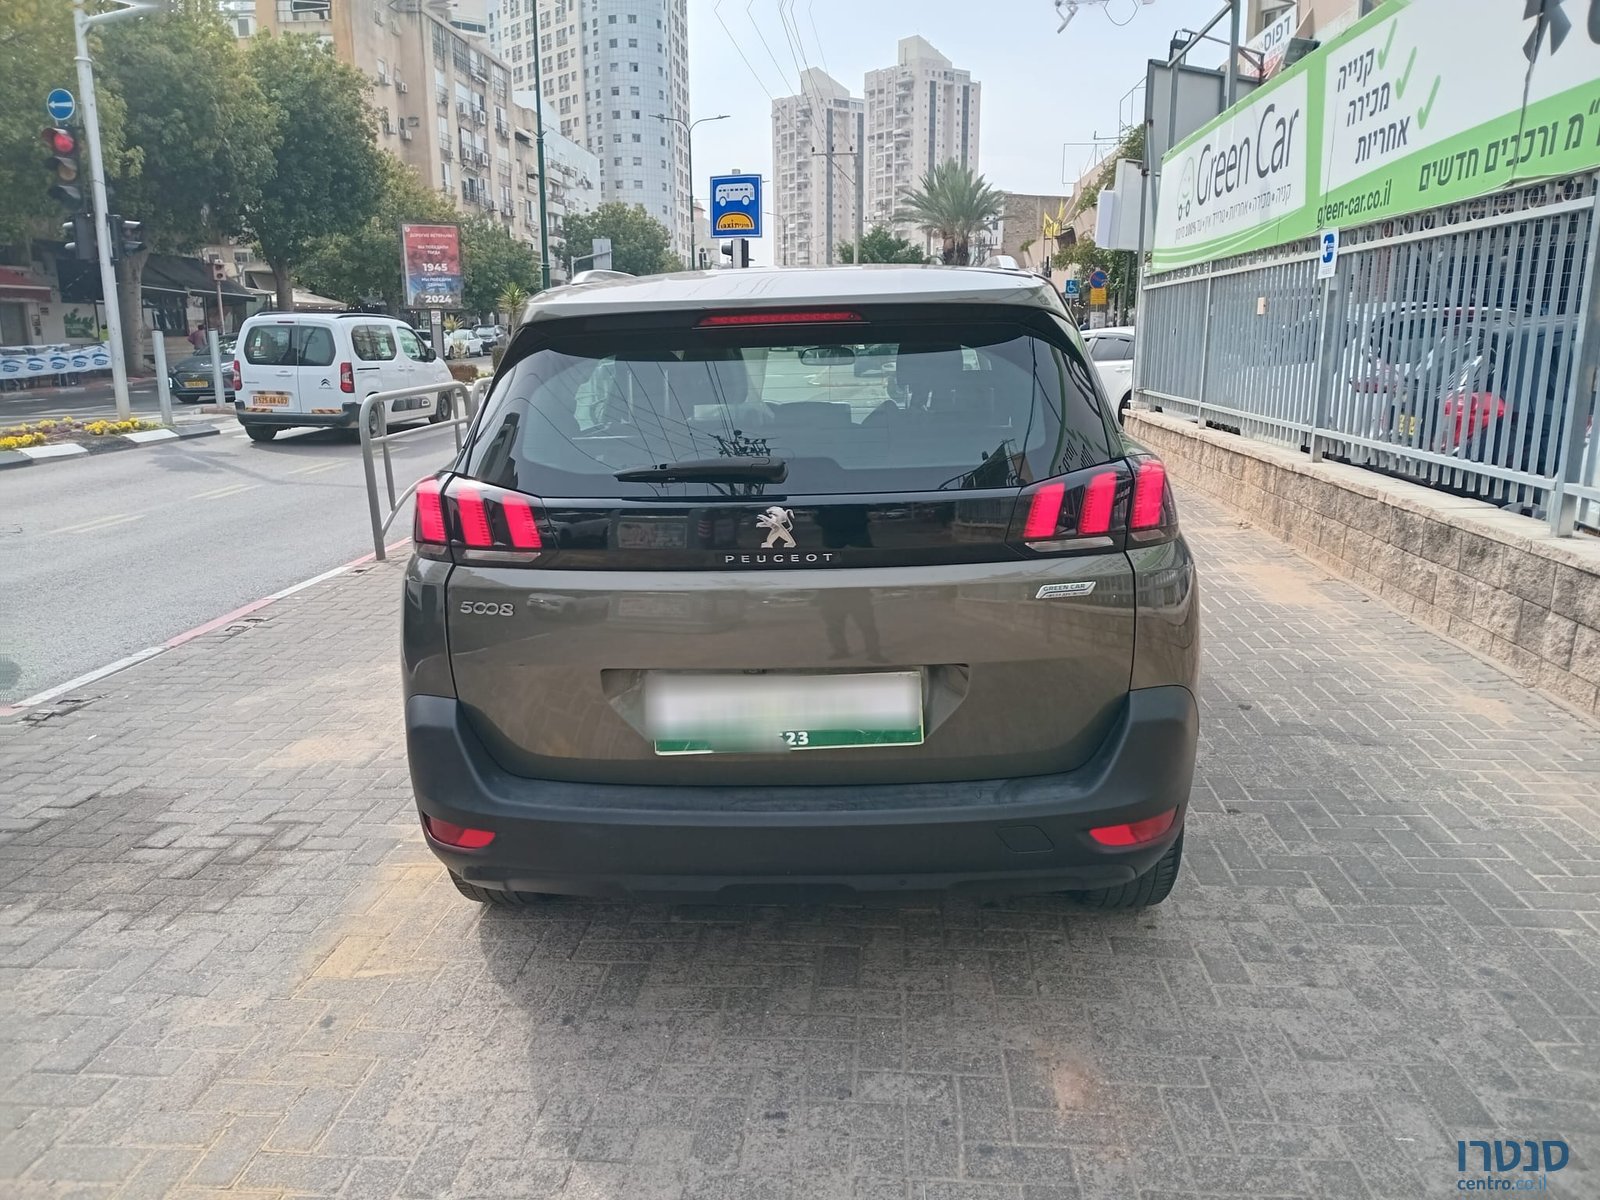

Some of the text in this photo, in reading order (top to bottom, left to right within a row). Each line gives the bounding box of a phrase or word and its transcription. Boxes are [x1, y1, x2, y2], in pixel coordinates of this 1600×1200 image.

[1264, 16, 1291, 51] דפוס
[1337, 48, 1375, 93] קנייה
[1346, 82, 1390, 127] מכירה
[1197, 103, 1300, 206] Green Car
[1355, 116, 1411, 164] אחריות
[1484, 121, 1559, 173] ורכבים
[1418, 148, 1479, 192] חדשים
[1316, 178, 1392, 228] green-car.co.il
[422, 263, 448, 272] 1945
[425, 294, 452, 304] 2024
[725, 553, 833, 563] PEUGEOT
[459, 601, 514, 616] 5008
